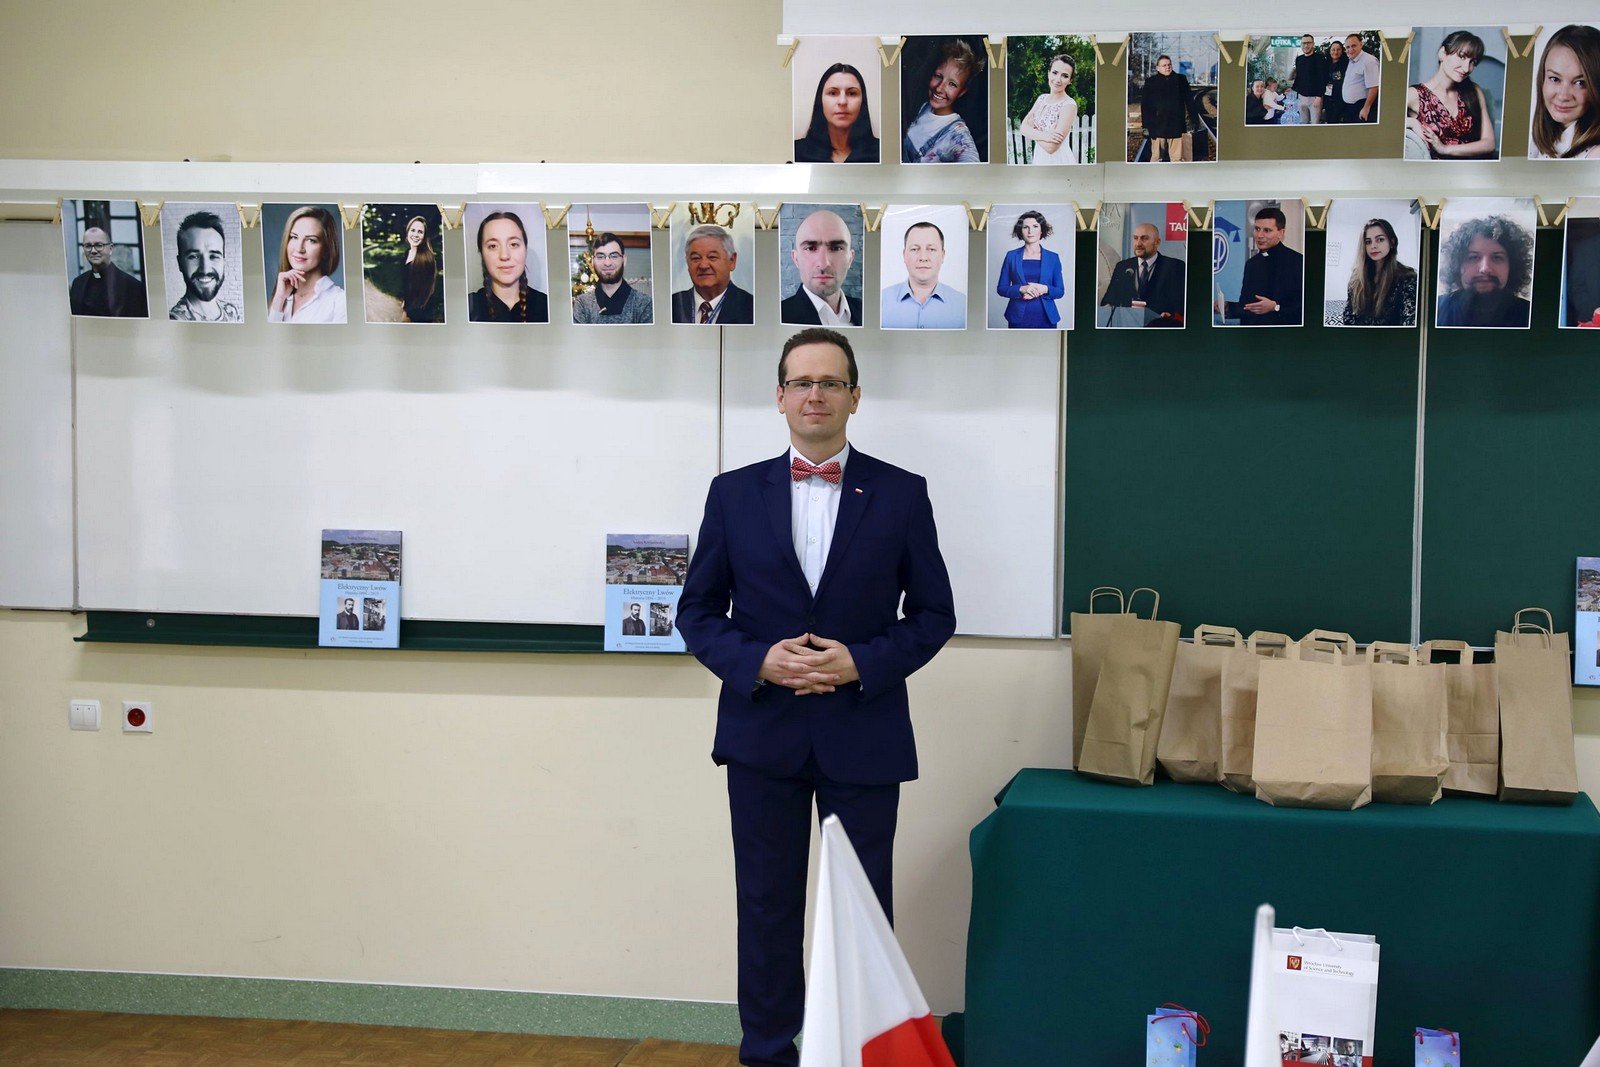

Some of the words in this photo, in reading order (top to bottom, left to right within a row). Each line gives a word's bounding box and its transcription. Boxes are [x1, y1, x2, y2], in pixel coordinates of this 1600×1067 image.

[337, 583, 369, 592] Elektryczny
[623, 588, 656, 597] Elektryczny
[657, 588, 675, 596] Lwów
